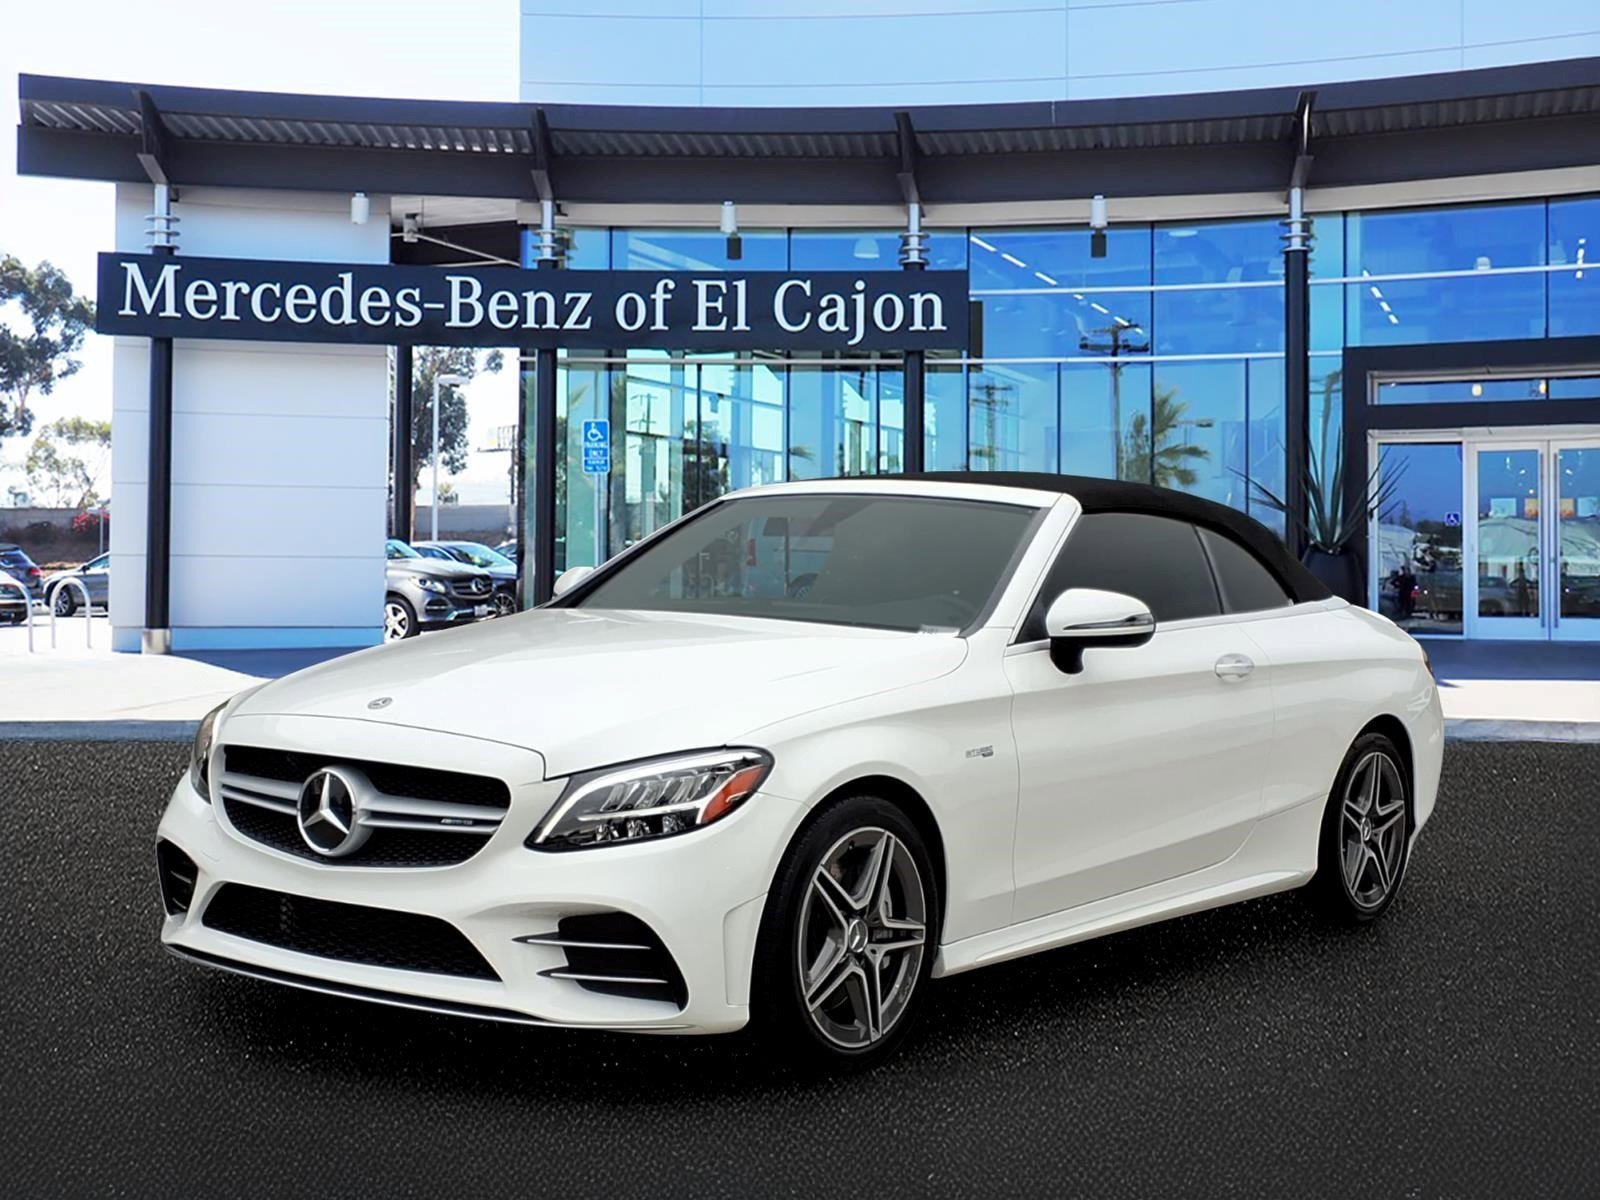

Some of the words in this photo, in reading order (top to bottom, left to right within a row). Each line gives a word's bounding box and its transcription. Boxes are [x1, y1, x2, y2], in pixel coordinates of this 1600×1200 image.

[118, 262, 593, 330] Mercedes-Benz
[615, 278, 675, 331] of
[692, 279, 751, 331] El
[773, 279, 947, 345] Cajon
